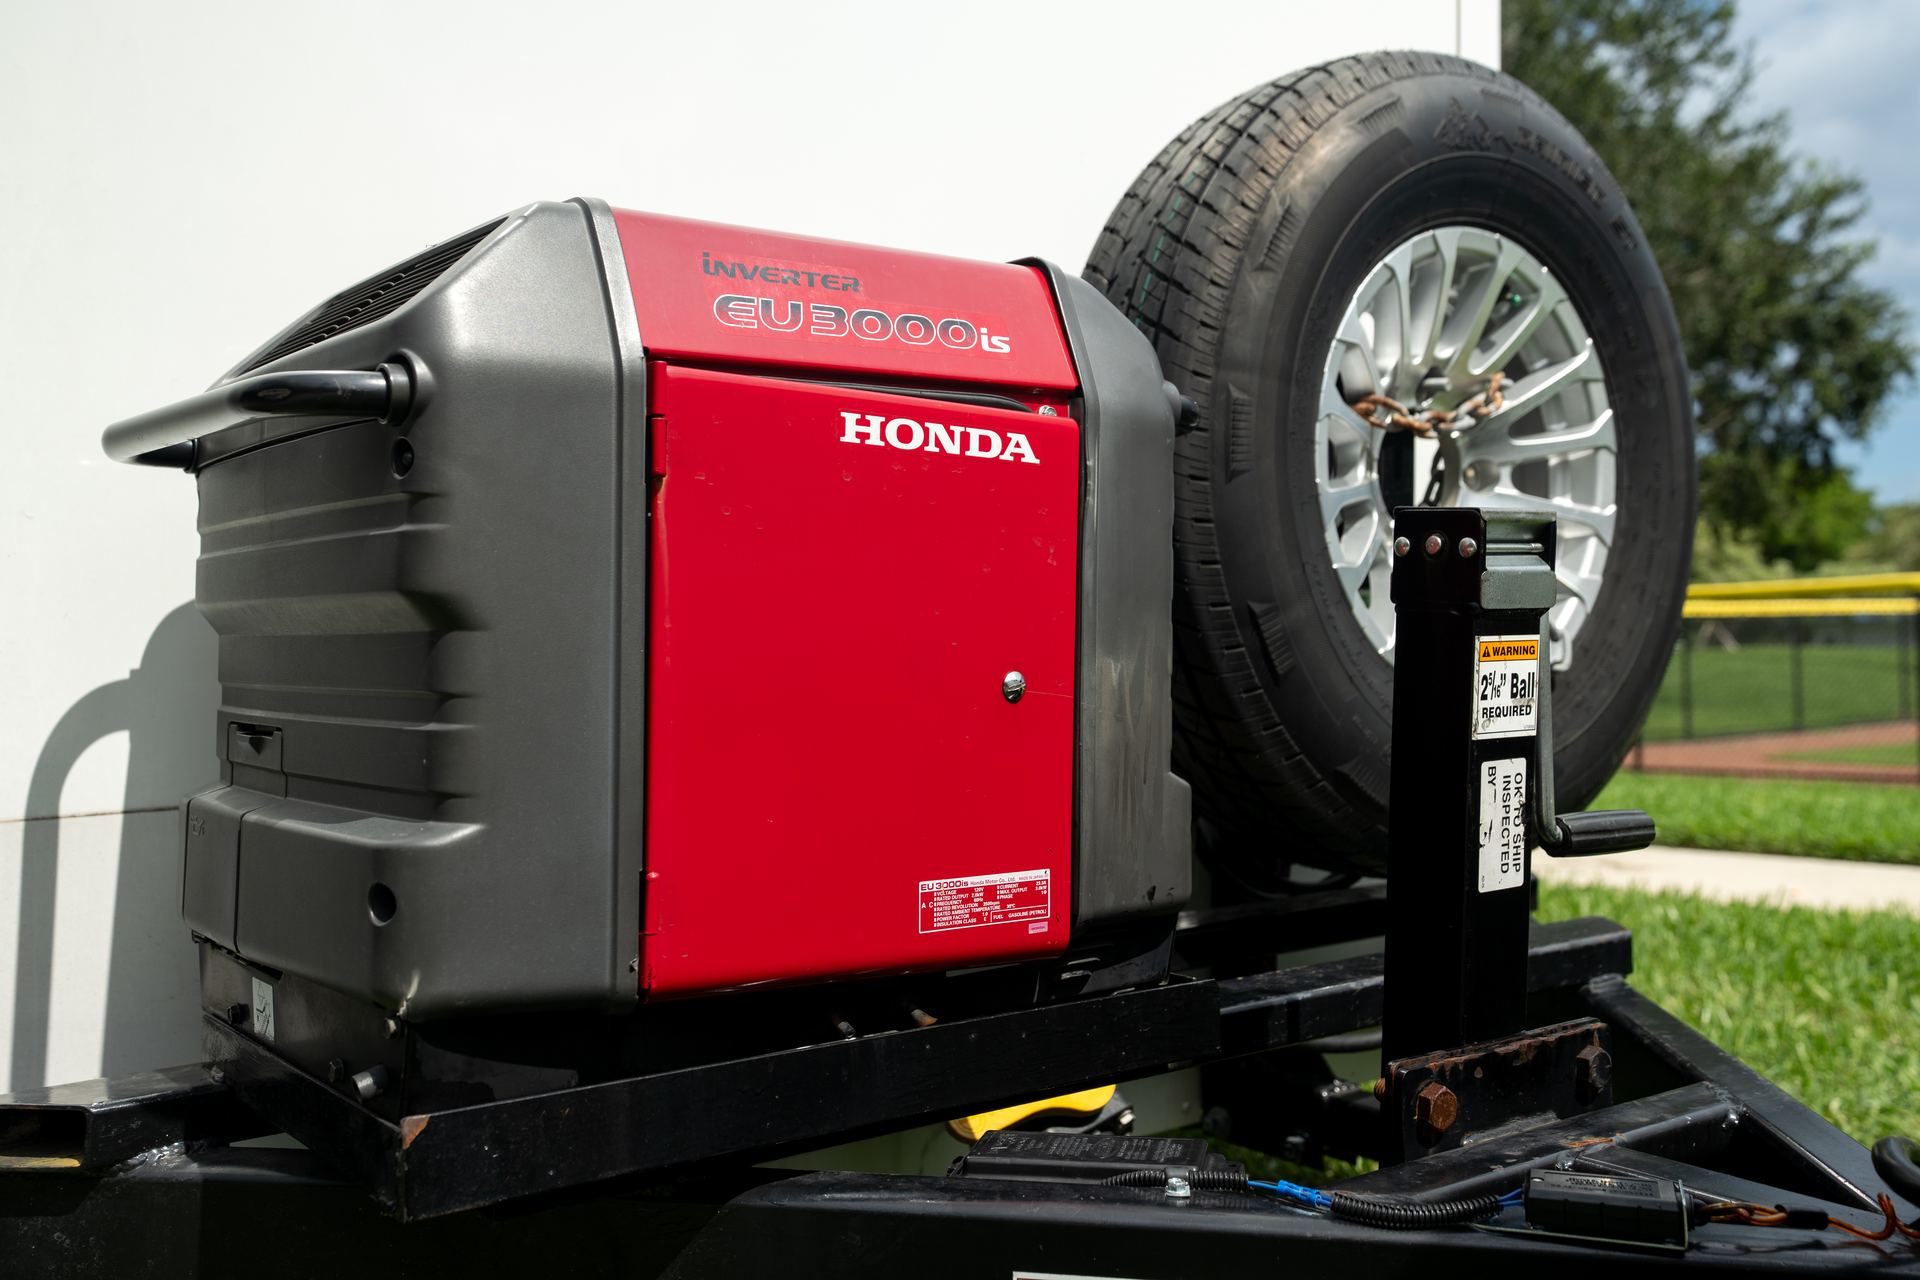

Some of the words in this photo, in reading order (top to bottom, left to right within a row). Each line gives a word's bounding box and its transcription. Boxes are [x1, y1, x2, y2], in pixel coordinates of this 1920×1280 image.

[839, 411, 1040, 465] HONDA
[1492, 645, 1535, 656] WARNING
[1510, 672, 1535, 700] Ball
[1482, 704, 1532, 719] REQUIRED
[1488, 766, 1496, 787] BY
[1513, 773, 1524, 797] OK
[1501, 775, 1512, 874] INSPECTED
[1512, 834, 1522, 872] SHIP
